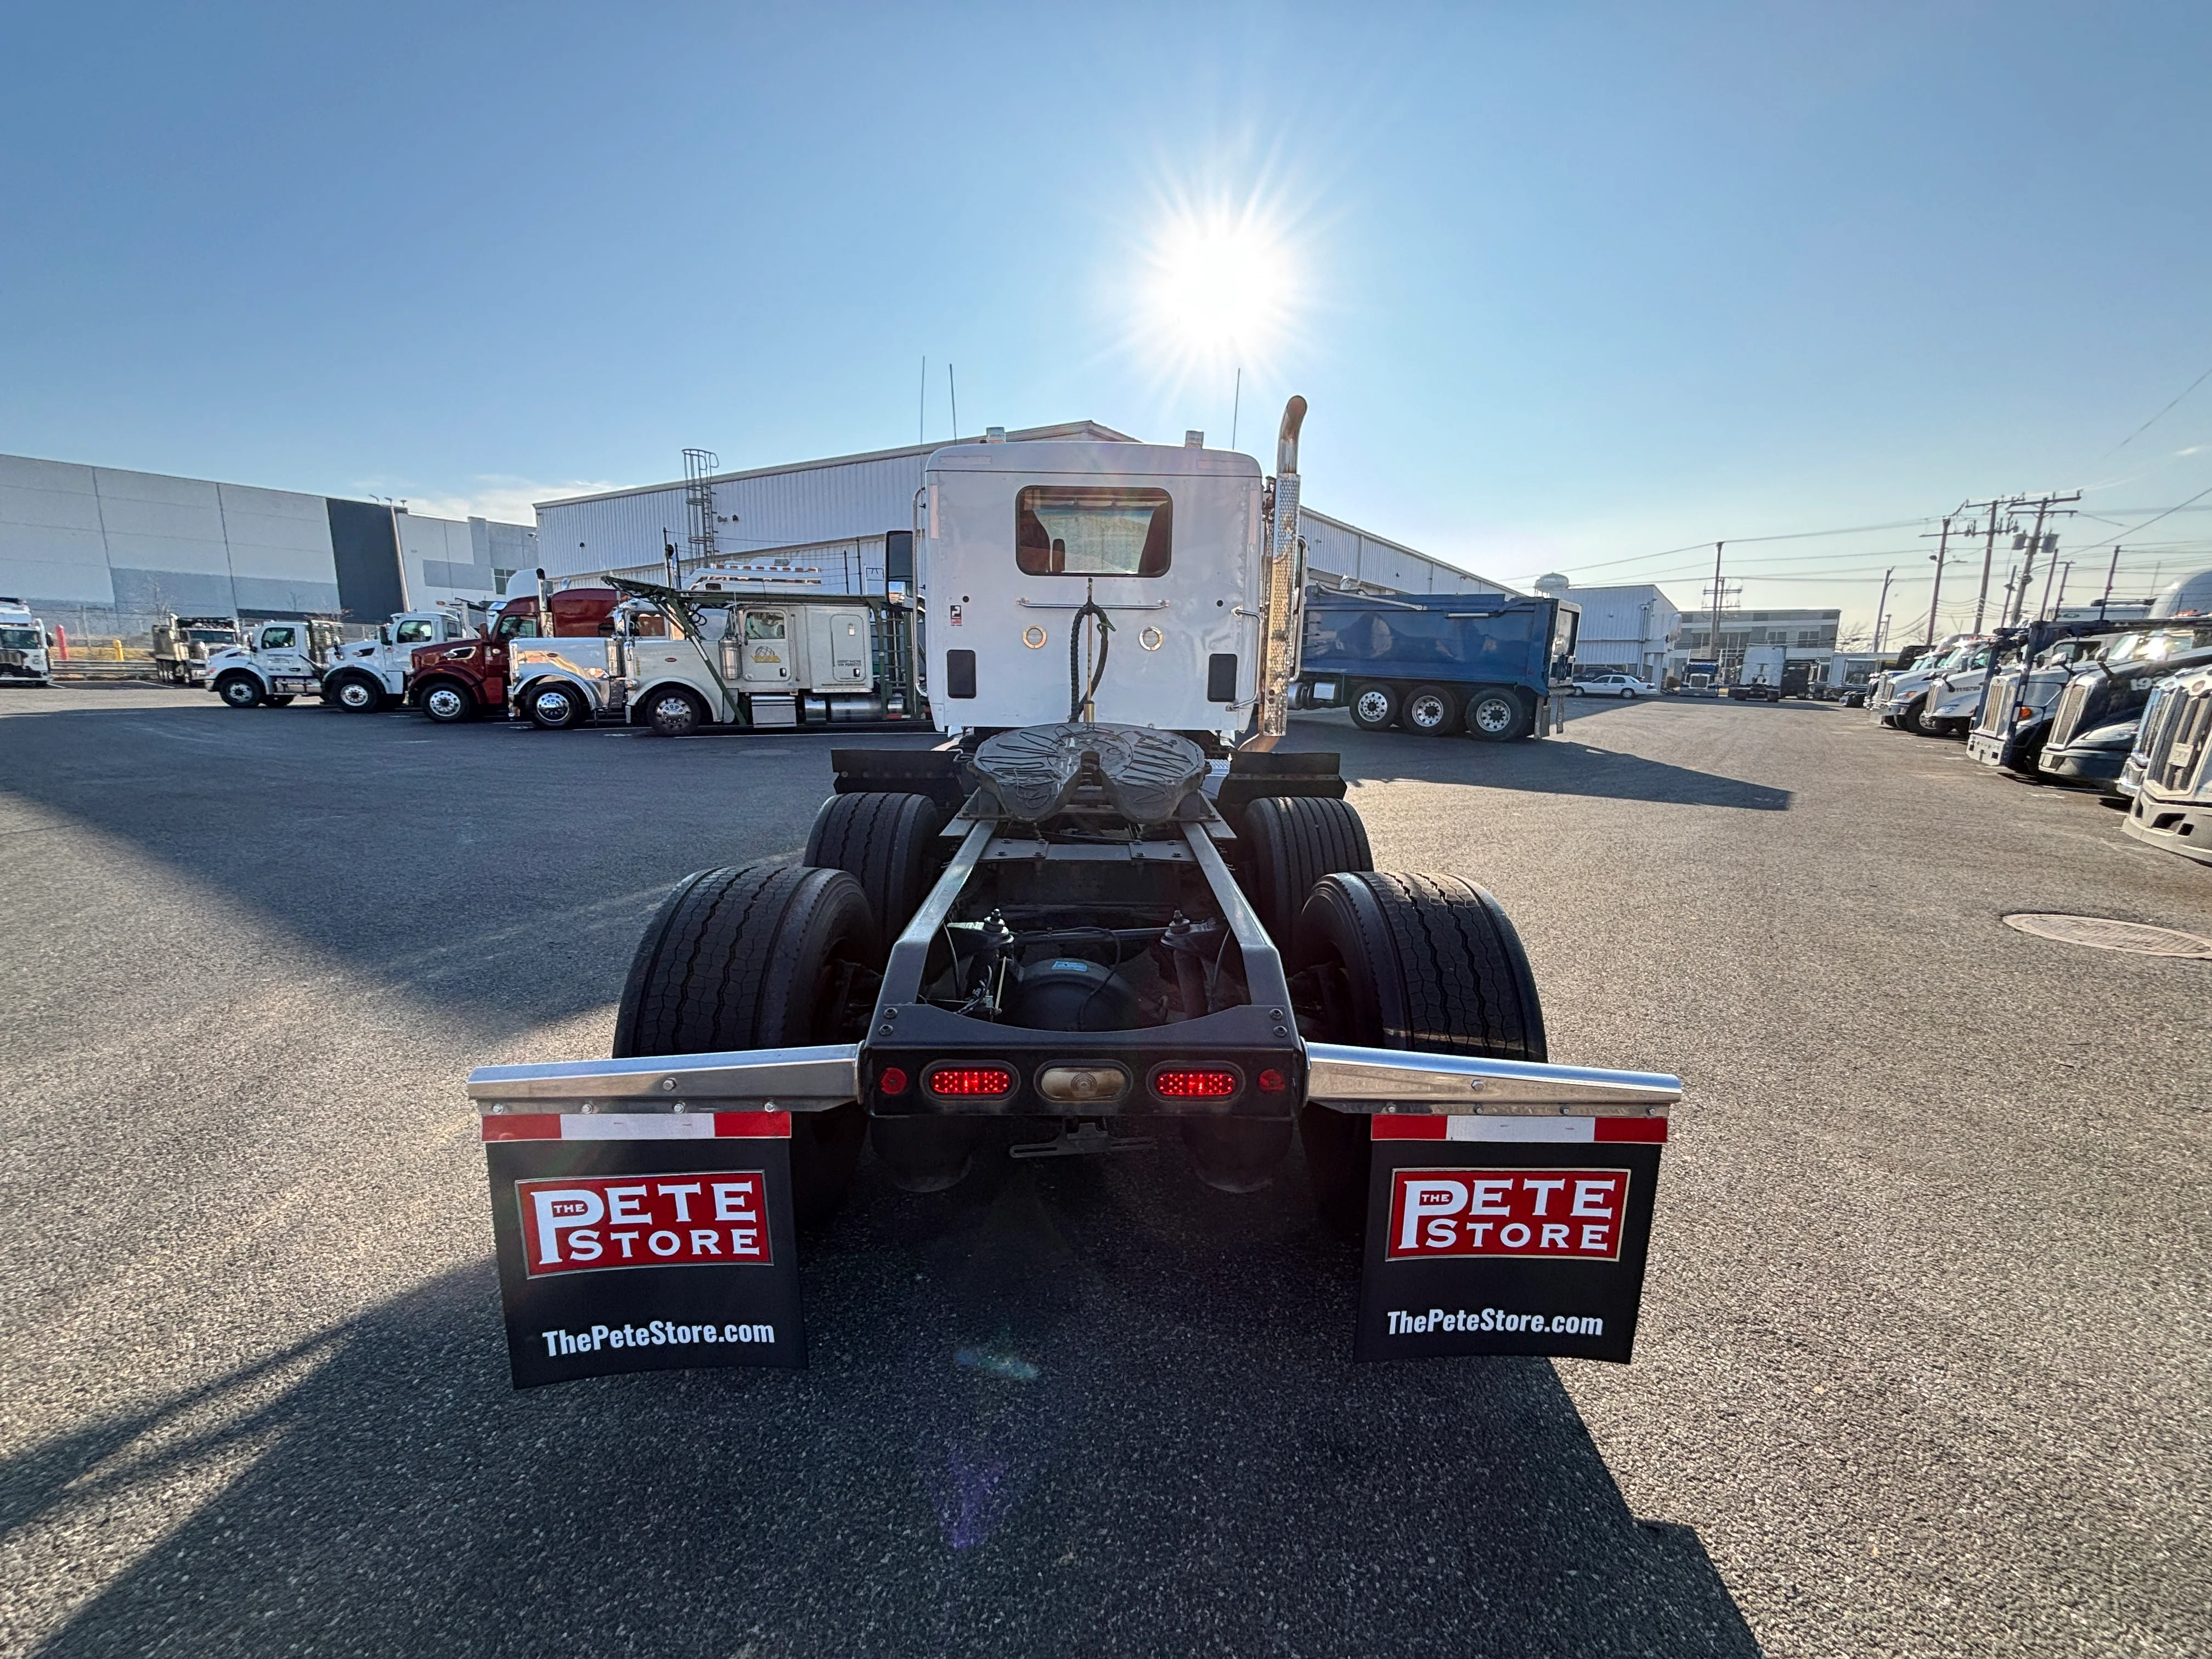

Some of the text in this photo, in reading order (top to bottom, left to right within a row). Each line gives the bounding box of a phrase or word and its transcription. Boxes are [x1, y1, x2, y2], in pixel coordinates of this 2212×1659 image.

[530, 1181, 757, 1265] THE PETE
[1398, 1178, 1616, 1250] THE PETE
[568, 1228, 760, 1261] STORE
[1425, 1218, 1610, 1251] STORE
[541, 1320, 775, 1357] ThePeteStore.com
[1387, 1307, 1603, 1336] ThePeteStore.com
